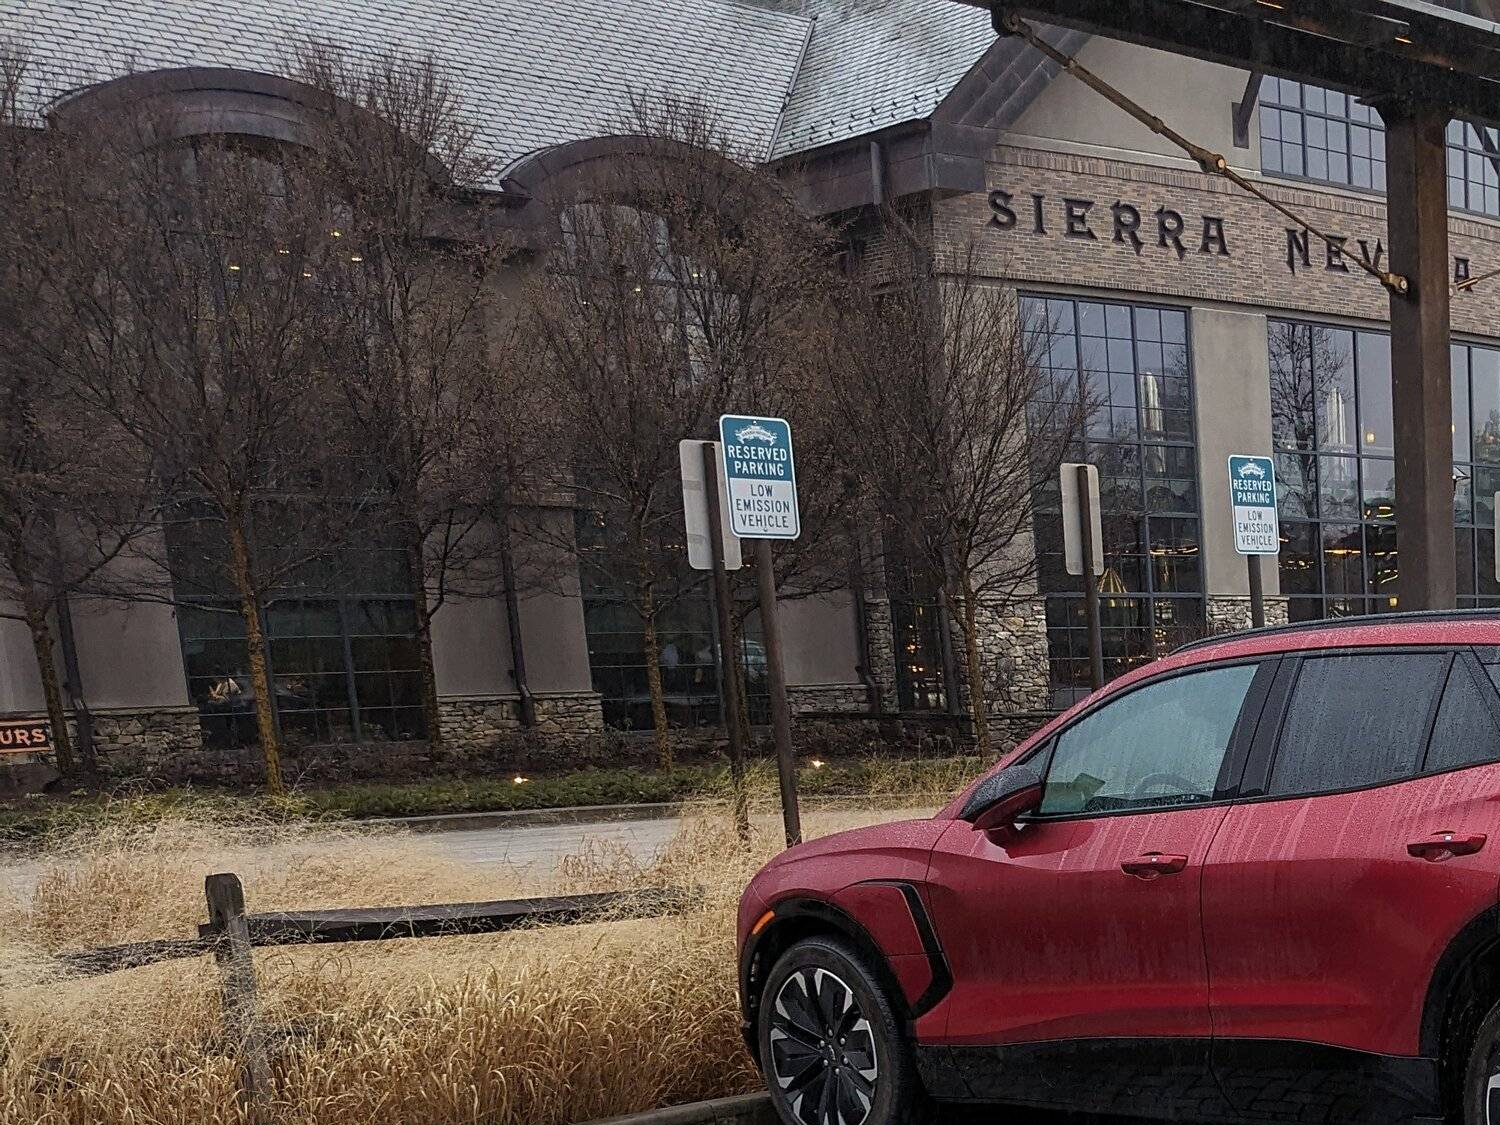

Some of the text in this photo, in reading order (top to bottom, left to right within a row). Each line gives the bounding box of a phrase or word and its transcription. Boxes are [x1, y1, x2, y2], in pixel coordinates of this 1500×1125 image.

[985, 189, 1231, 260] SIERRA
[1285, 227, 1474, 293] NEVA
[728, 445, 787, 461] RESERVED
[734, 461, 784, 476] PARKING
[750, 484, 773, 497] LOW
[1233, 479, 1272, 492] RESERVED
[1237, 492, 1270, 503] PARKING
[736, 499, 790, 513] EMISSION
[741, 514, 789, 528] VEHICLE
[1247, 511, 1263, 520] LOW
[1238, 522, 1273, 533] EMISSION
[1241, 535, 1272, 546] VEHICLE
